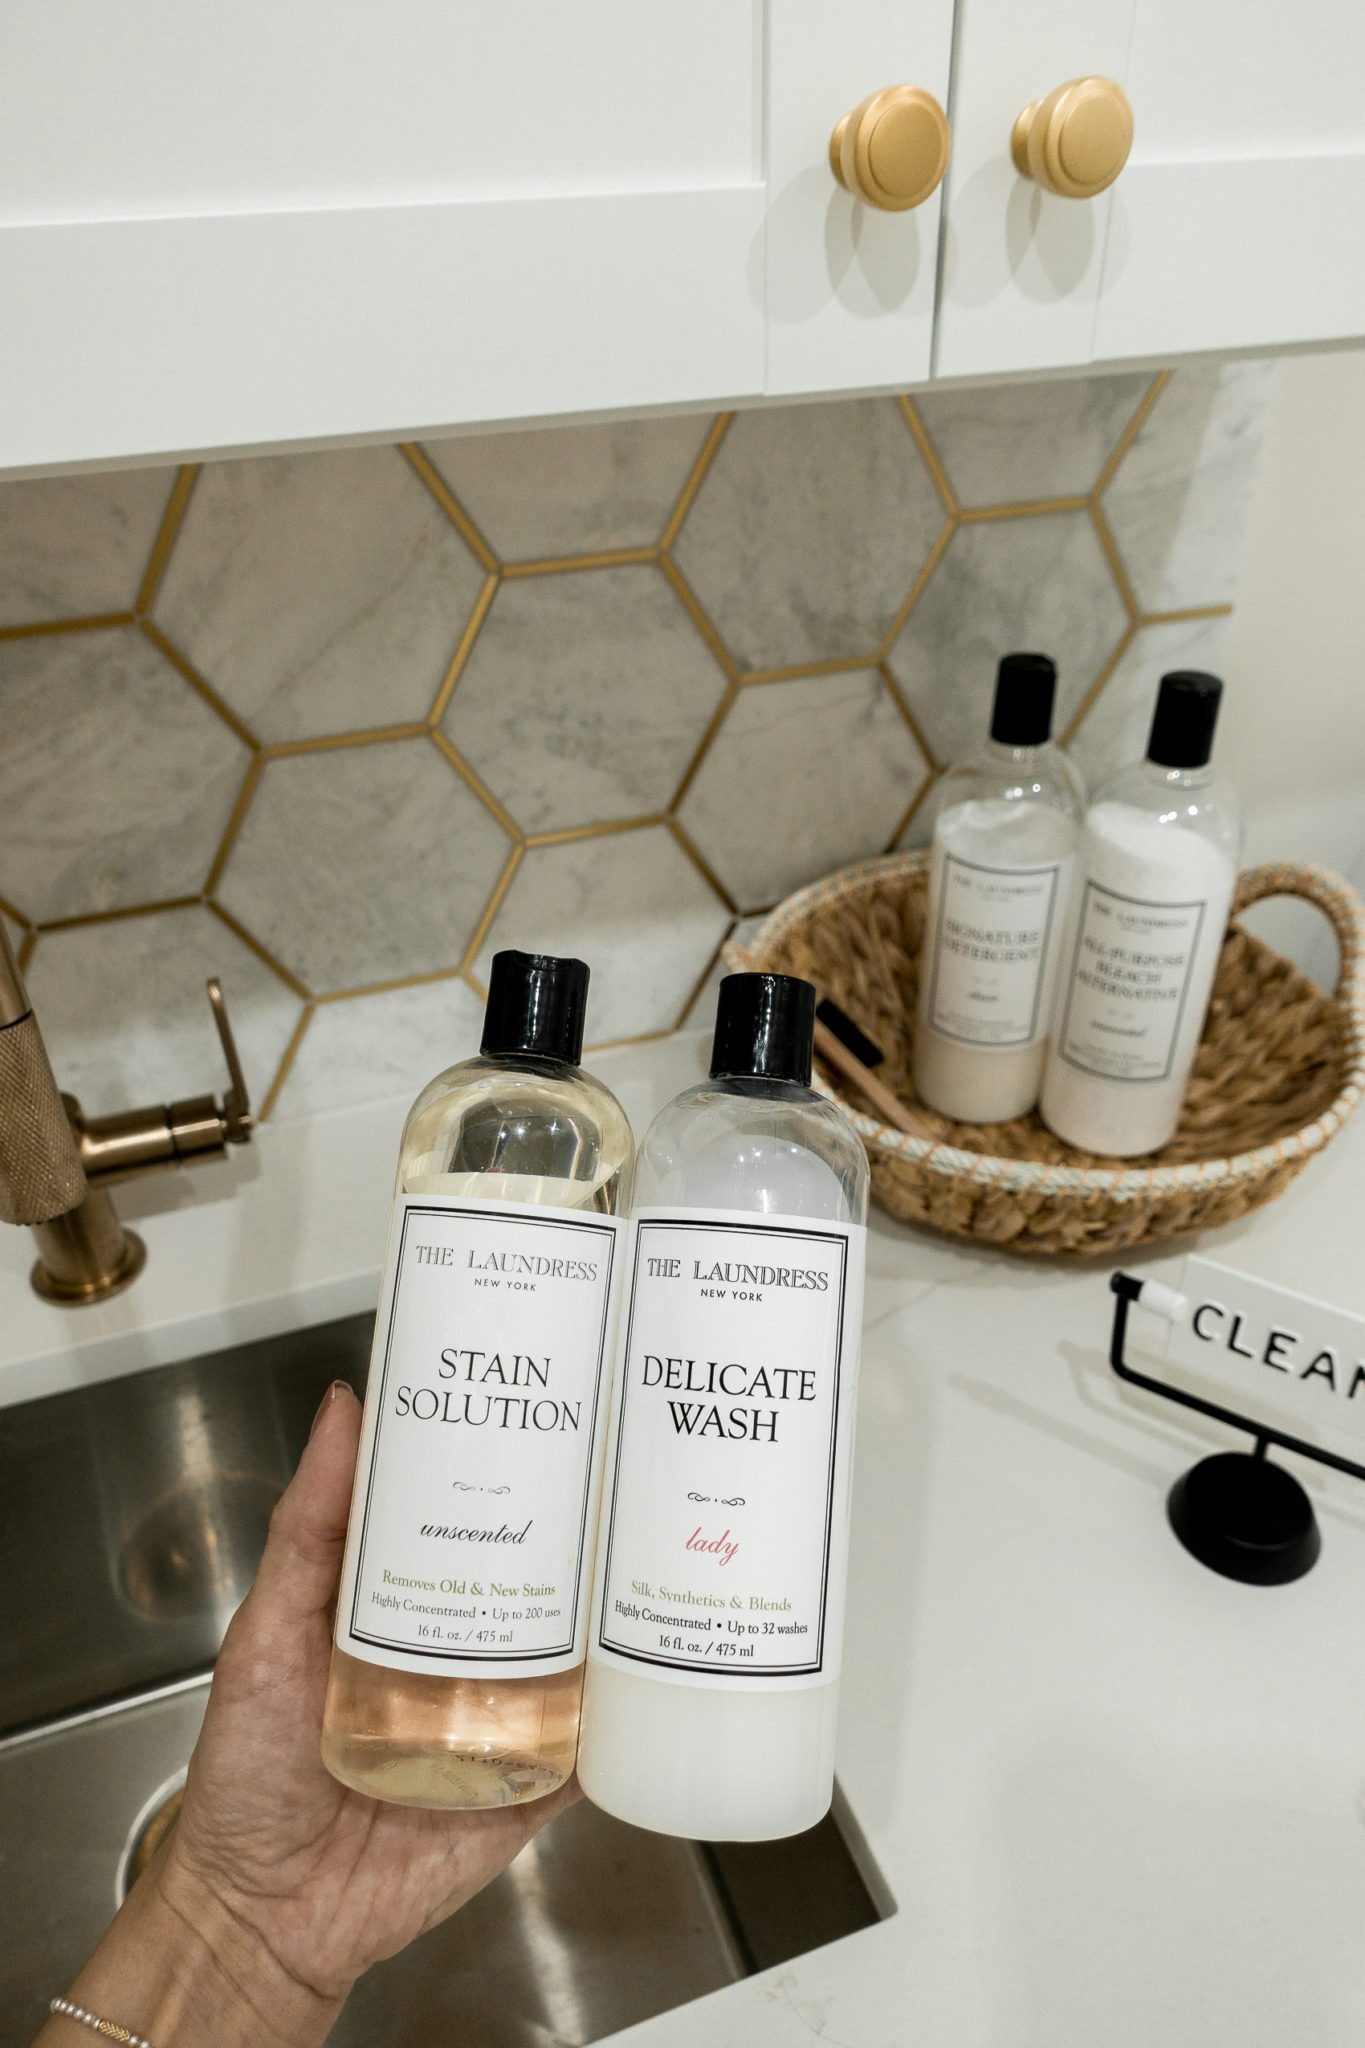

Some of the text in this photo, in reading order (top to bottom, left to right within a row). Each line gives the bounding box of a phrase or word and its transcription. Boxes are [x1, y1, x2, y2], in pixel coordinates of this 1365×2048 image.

[416, 1245, 598, 1281] THE LAUNDRESS
[647, 1258, 829, 1291] THE LAUNDRESS
[474, 1278, 537, 1292] NEW YORK
[700, 1288, 763, 1302] NEW YORK
[438, 1348, 551, 1388] STAIN
[642, 1355, 816, 1401] DELICATE
[395, 1386, 582, 1431] SOLUTION
[666, 1400, 779, 1442] WASH
[420, 1520, 533, 1545] unscented
[685, 1526, 740, 1566] lady
[382, 1569, 556, 1597] Removes Old & New Stains
[631, 1580, 792, 1611] Silk, Synthetics & Blends
[372, 1592, 561, 1622] Highly Concentrated Up to 200 uses
[614, 1600, 808, 1636] Highly Concentrated Up to 32 washes
[417, 1624, 514, 1643] 16 fl. oz. / 475 ml
[659, 1635, 754, 1657] 16 fl. oz. / 475 ml
